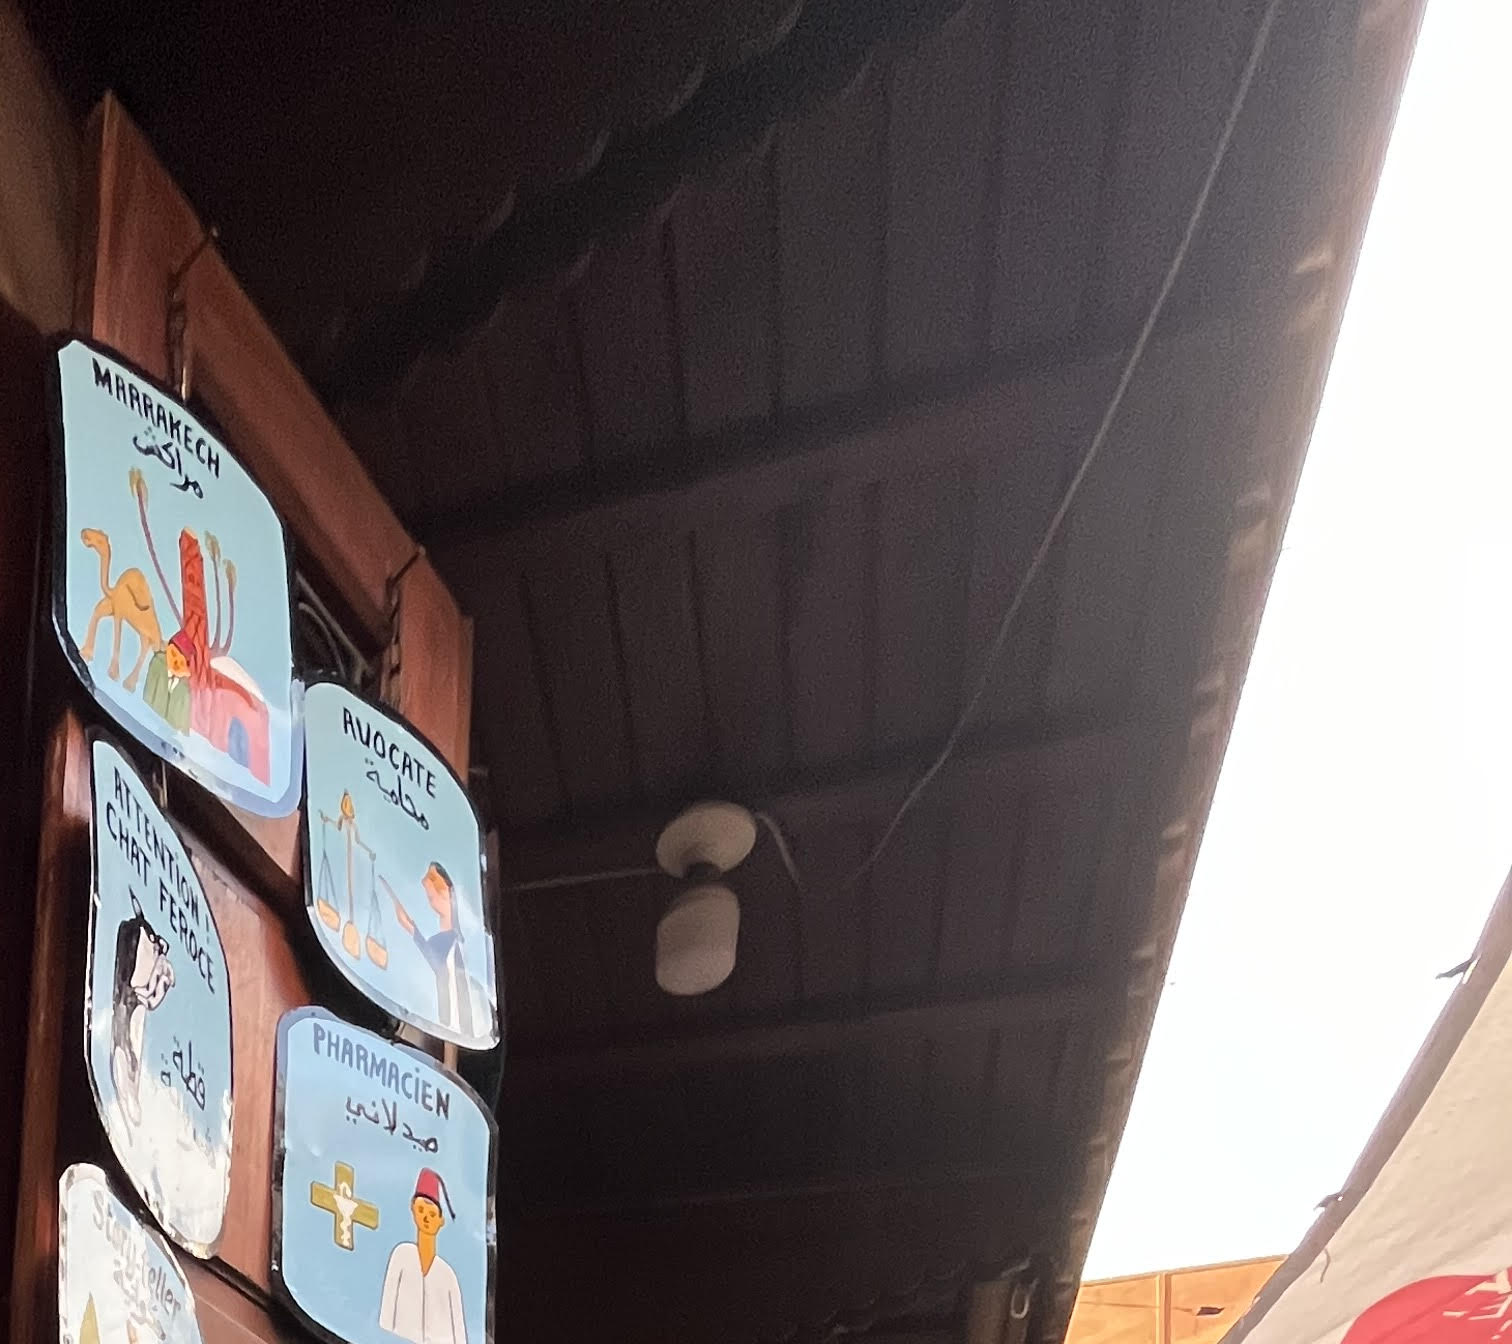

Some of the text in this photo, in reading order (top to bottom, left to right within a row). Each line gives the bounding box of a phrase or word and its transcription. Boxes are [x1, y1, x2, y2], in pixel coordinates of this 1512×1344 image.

[92, 357, 221, 479] MARRAKECH
[343, 706, 438, 797] AVOCATE
[105, 802, 216, 995] CHAT FEROCE
[312, 1023, 451, 1120] PHARMACIEN
